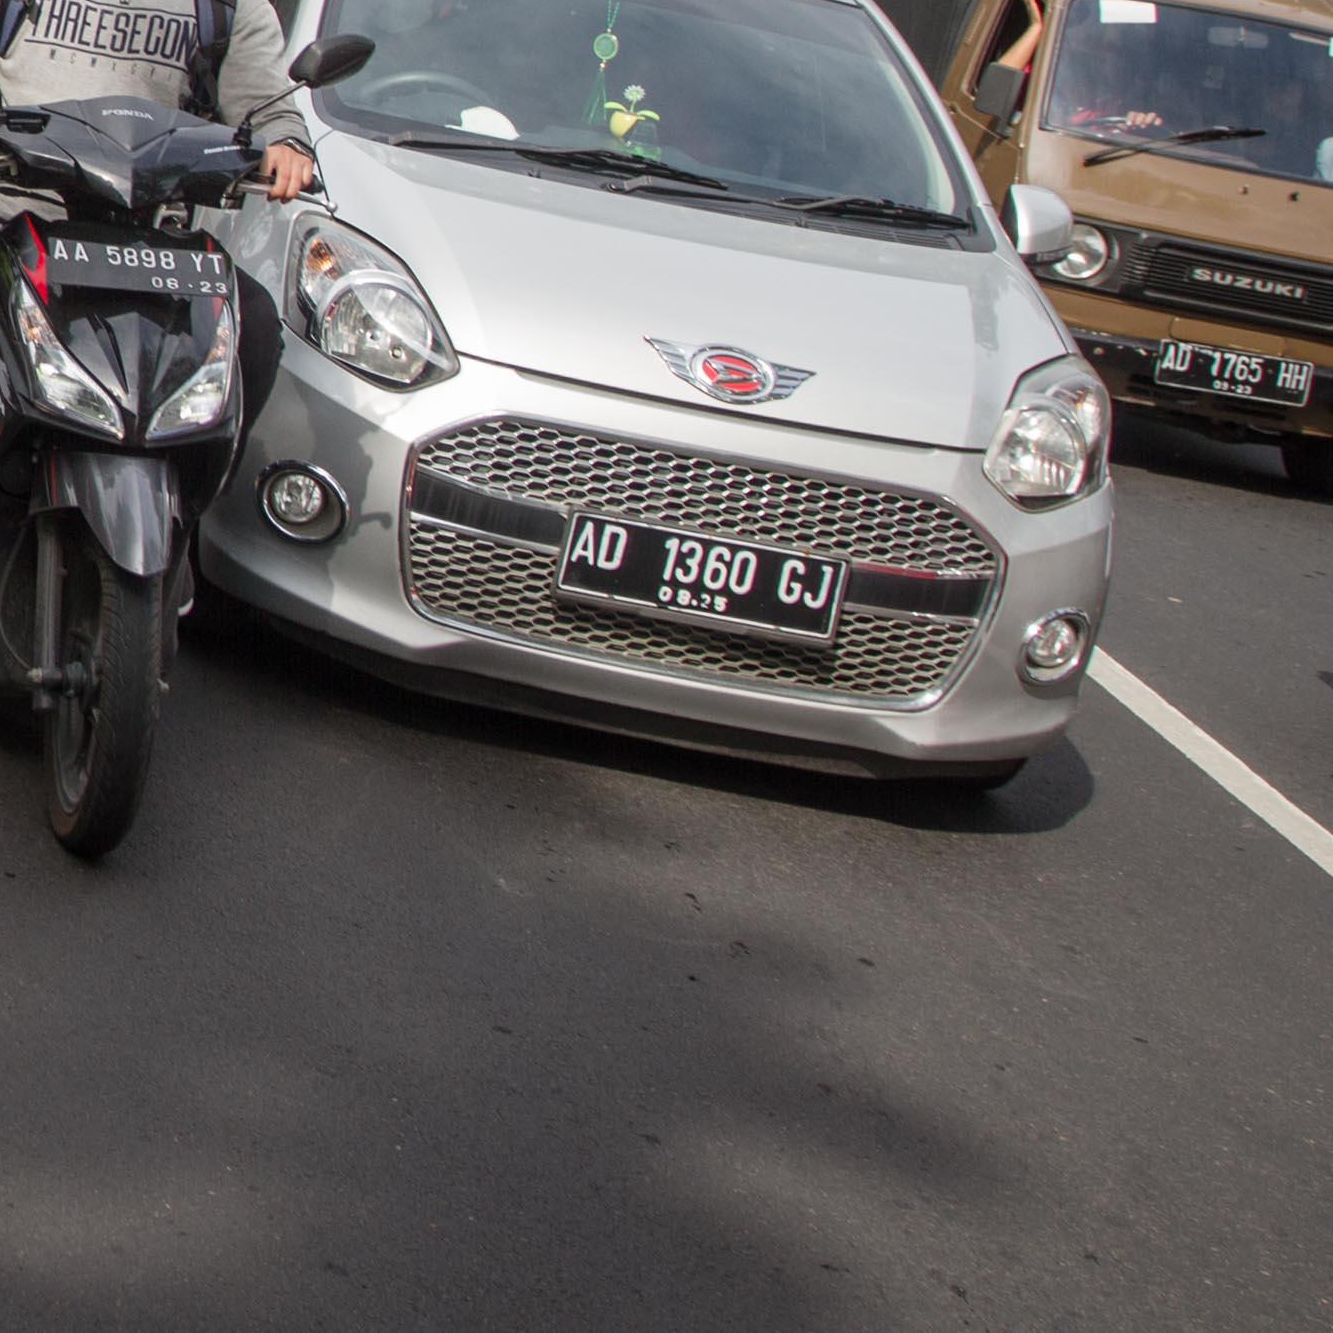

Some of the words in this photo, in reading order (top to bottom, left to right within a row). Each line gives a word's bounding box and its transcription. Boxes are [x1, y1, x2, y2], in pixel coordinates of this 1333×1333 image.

[53, 239, 90, 263] AA
[105, 245, 176, 271] 5898
[190, 252, 223, 275] YT
[1191, 268, 1305, 299] SUZUKI
[1161, 343, 1193, 372] AD
[1210, 351, 1265, 384] 1765
[1276, 362, 1309, 391] HH
[570, 520, 629, 571] AD
[662, 537, 758, 596] 1360
[777, 558, 835, 610] GJ
